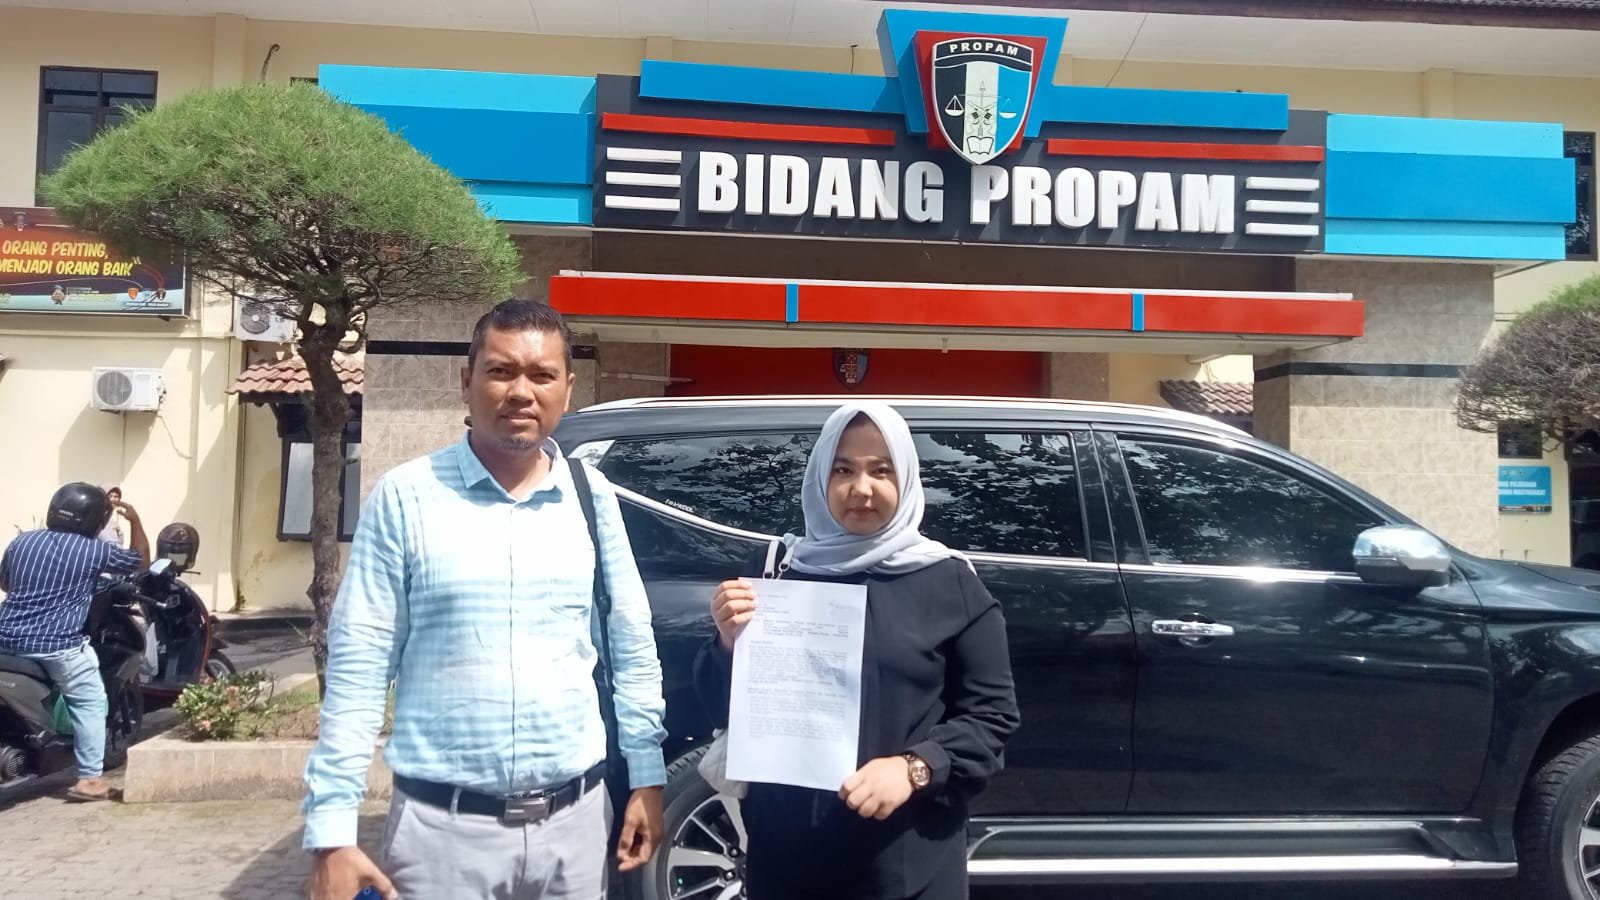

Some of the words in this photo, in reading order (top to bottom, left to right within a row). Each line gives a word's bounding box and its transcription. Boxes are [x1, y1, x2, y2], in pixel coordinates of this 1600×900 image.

[949, 42, 1019, 56] PROPAM
[698, 151, 944, 224] BIDANG
[969, 164, 1235, 235] PROPAM
[2, 240, 48, 256] ORANG
[51, 241, 109, 259] PENTING,
[0, 258, 53, 275] MENJADI
[56, 260, 99, 276] ORANG
